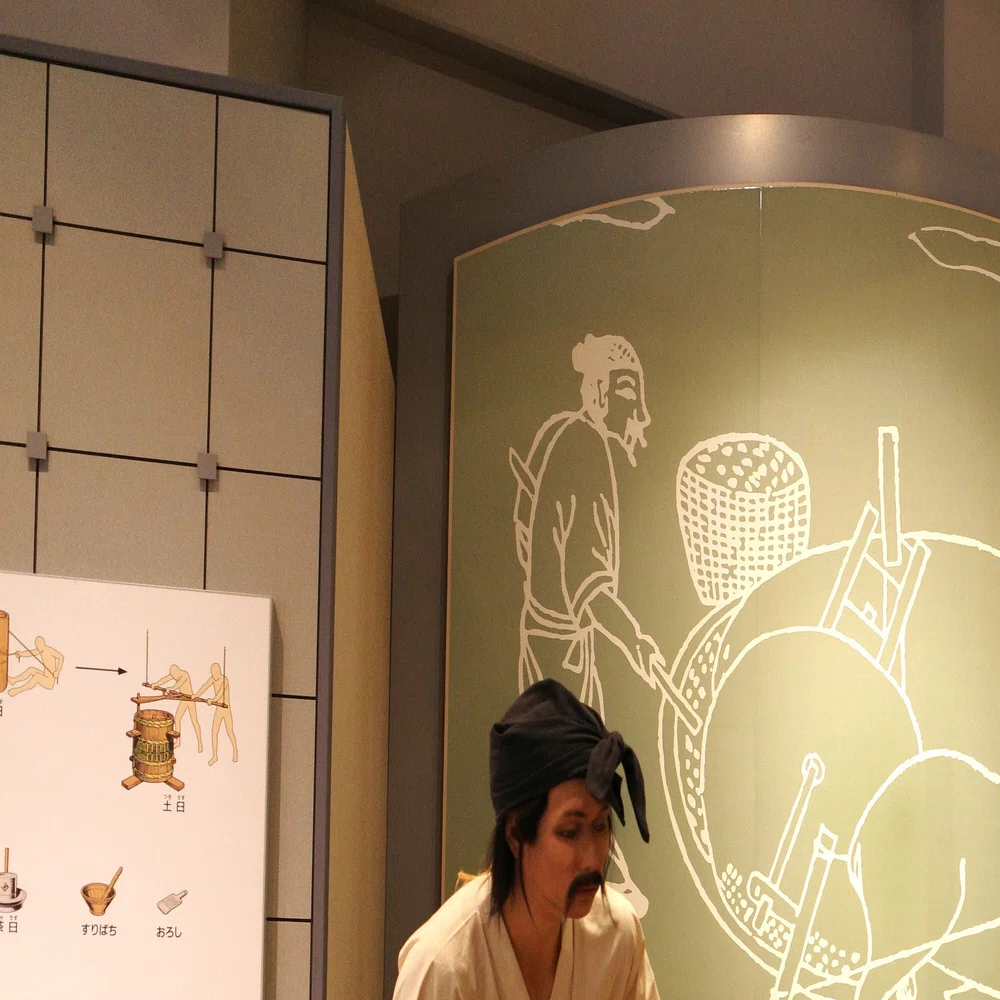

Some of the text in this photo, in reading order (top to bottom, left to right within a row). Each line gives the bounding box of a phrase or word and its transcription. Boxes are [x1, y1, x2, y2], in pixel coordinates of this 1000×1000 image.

[81, 924, 117, 936] すりばち
[156, 926, 182, 938] おろし
